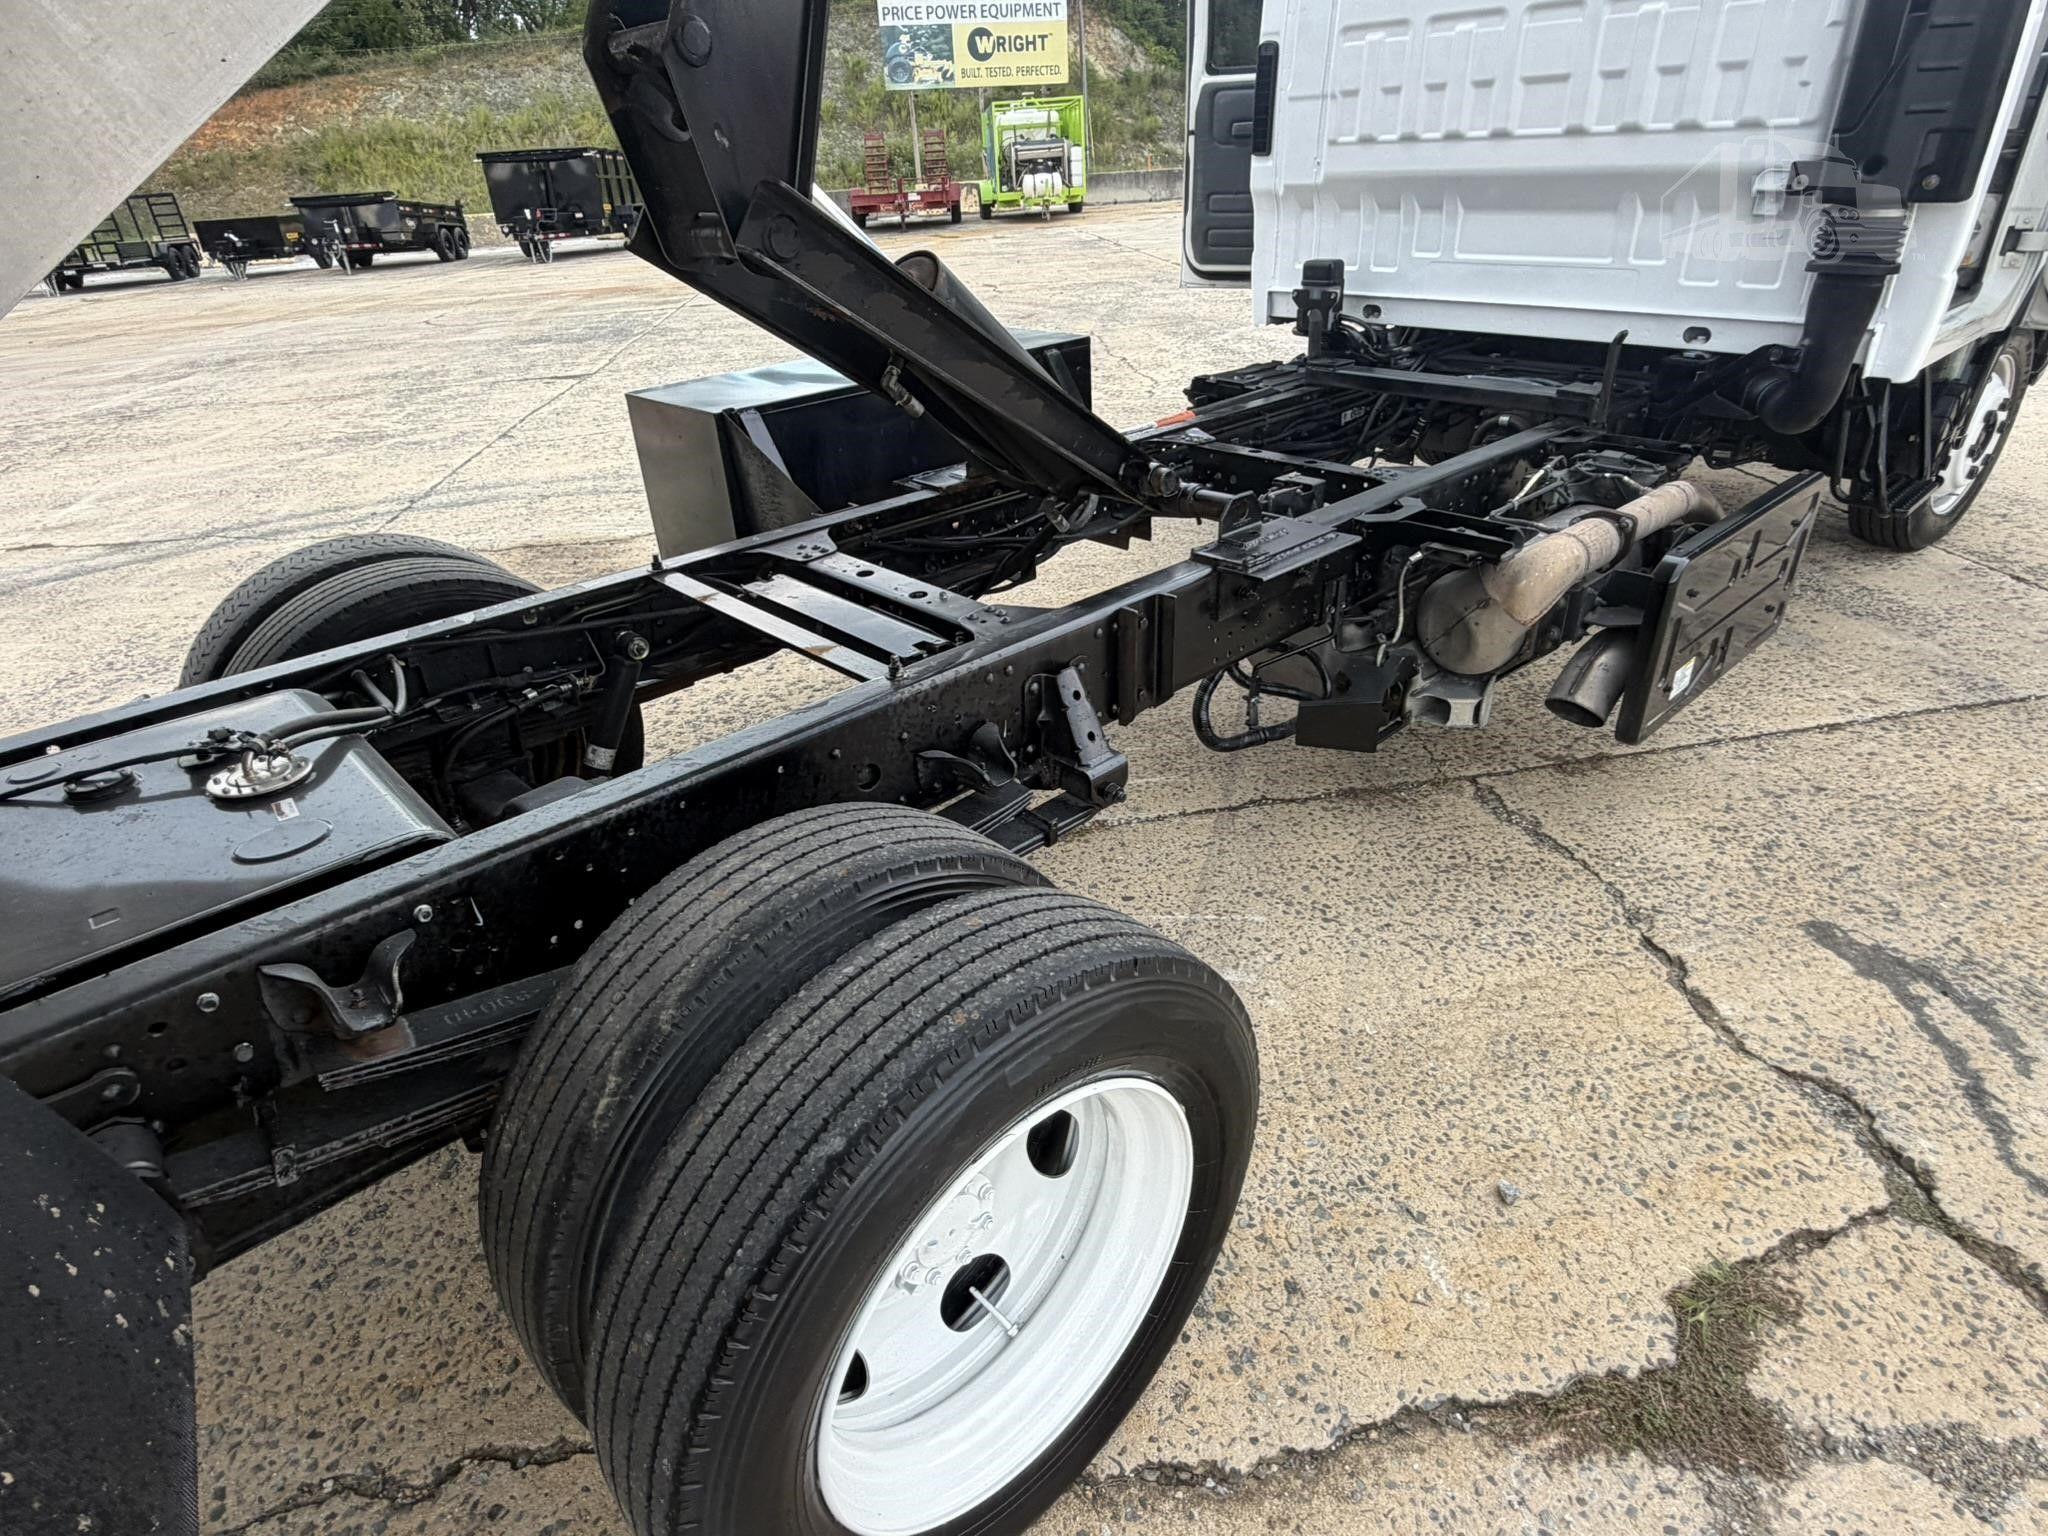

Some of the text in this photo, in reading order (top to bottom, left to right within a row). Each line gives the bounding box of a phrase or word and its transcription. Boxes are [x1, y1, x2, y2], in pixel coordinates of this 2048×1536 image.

[882, 2, 1061, 21] PRICE POWER EQUIPMENT
[961, 65, 1062, 79] BUILT. TESTED. PERFECTED.
